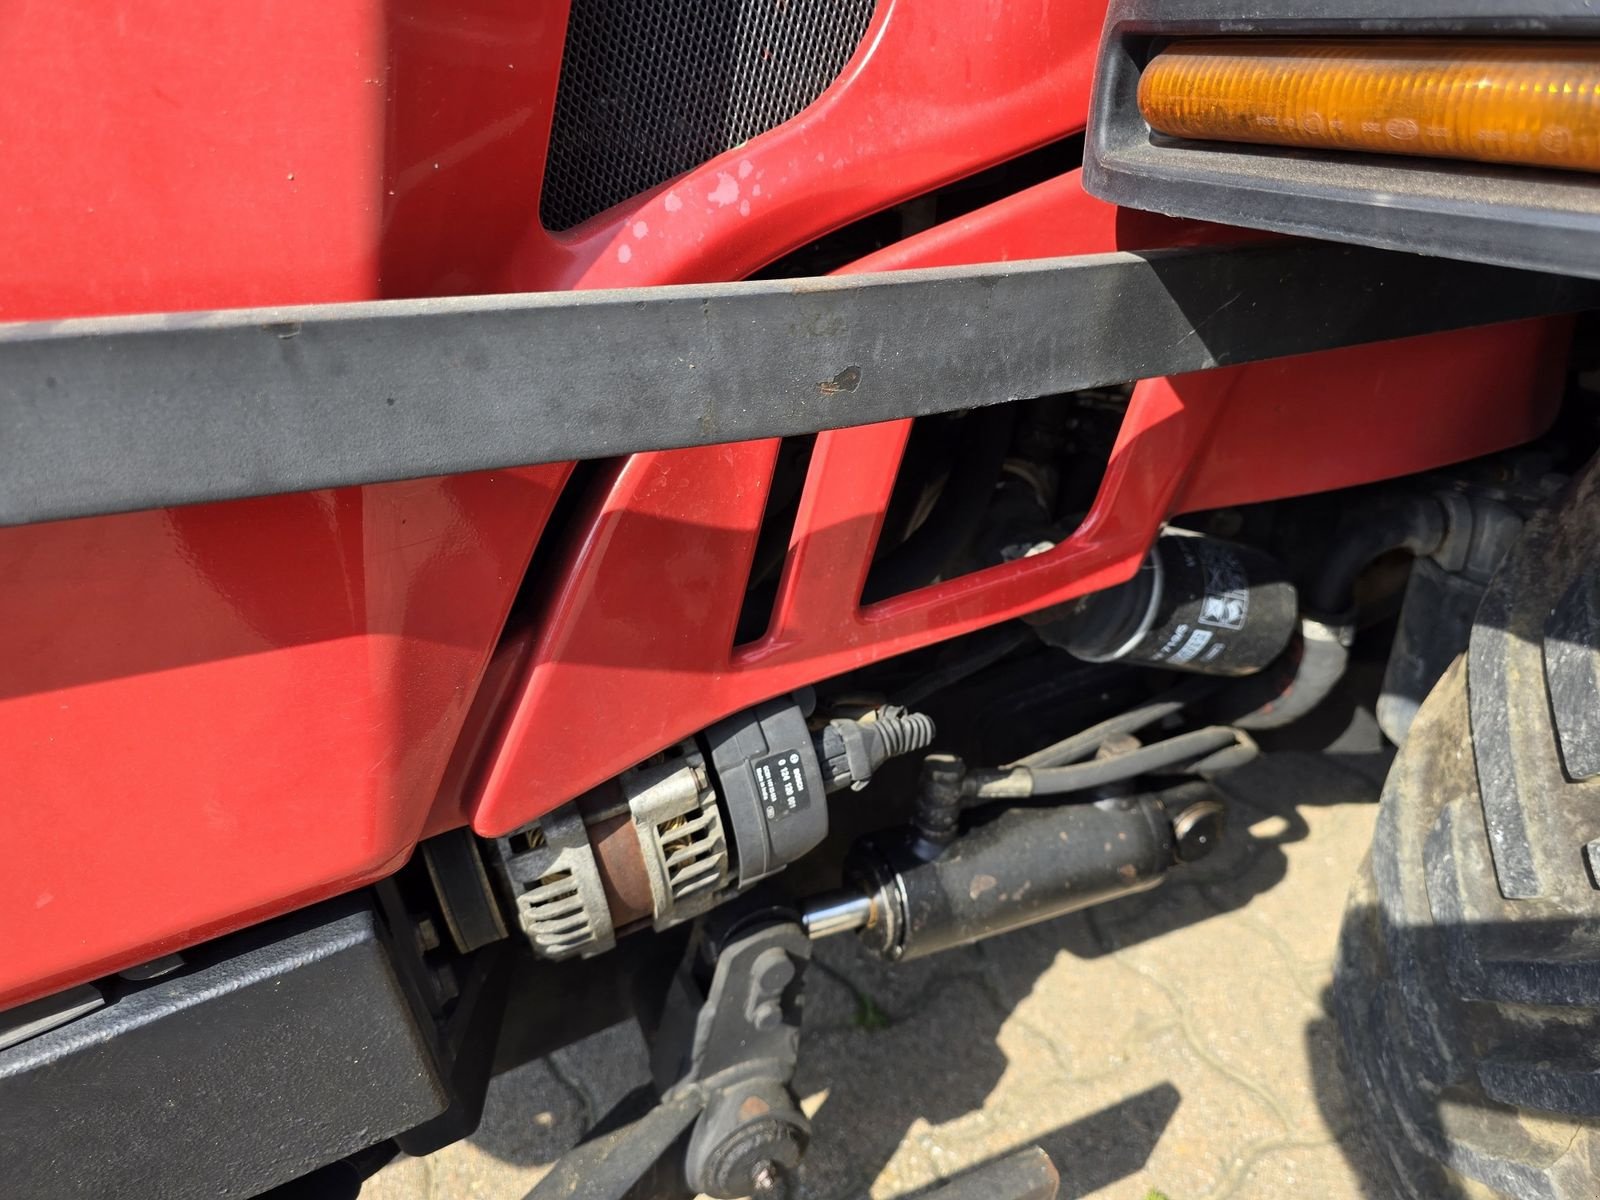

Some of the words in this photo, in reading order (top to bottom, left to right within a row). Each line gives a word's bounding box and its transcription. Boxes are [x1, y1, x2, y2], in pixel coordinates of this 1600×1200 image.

[756, 767, 764, 782] Made
[780, 767, 791, 781] 124
[793, 768, 804, 792] BOSCH
[784, 782, 794, 796] 120
